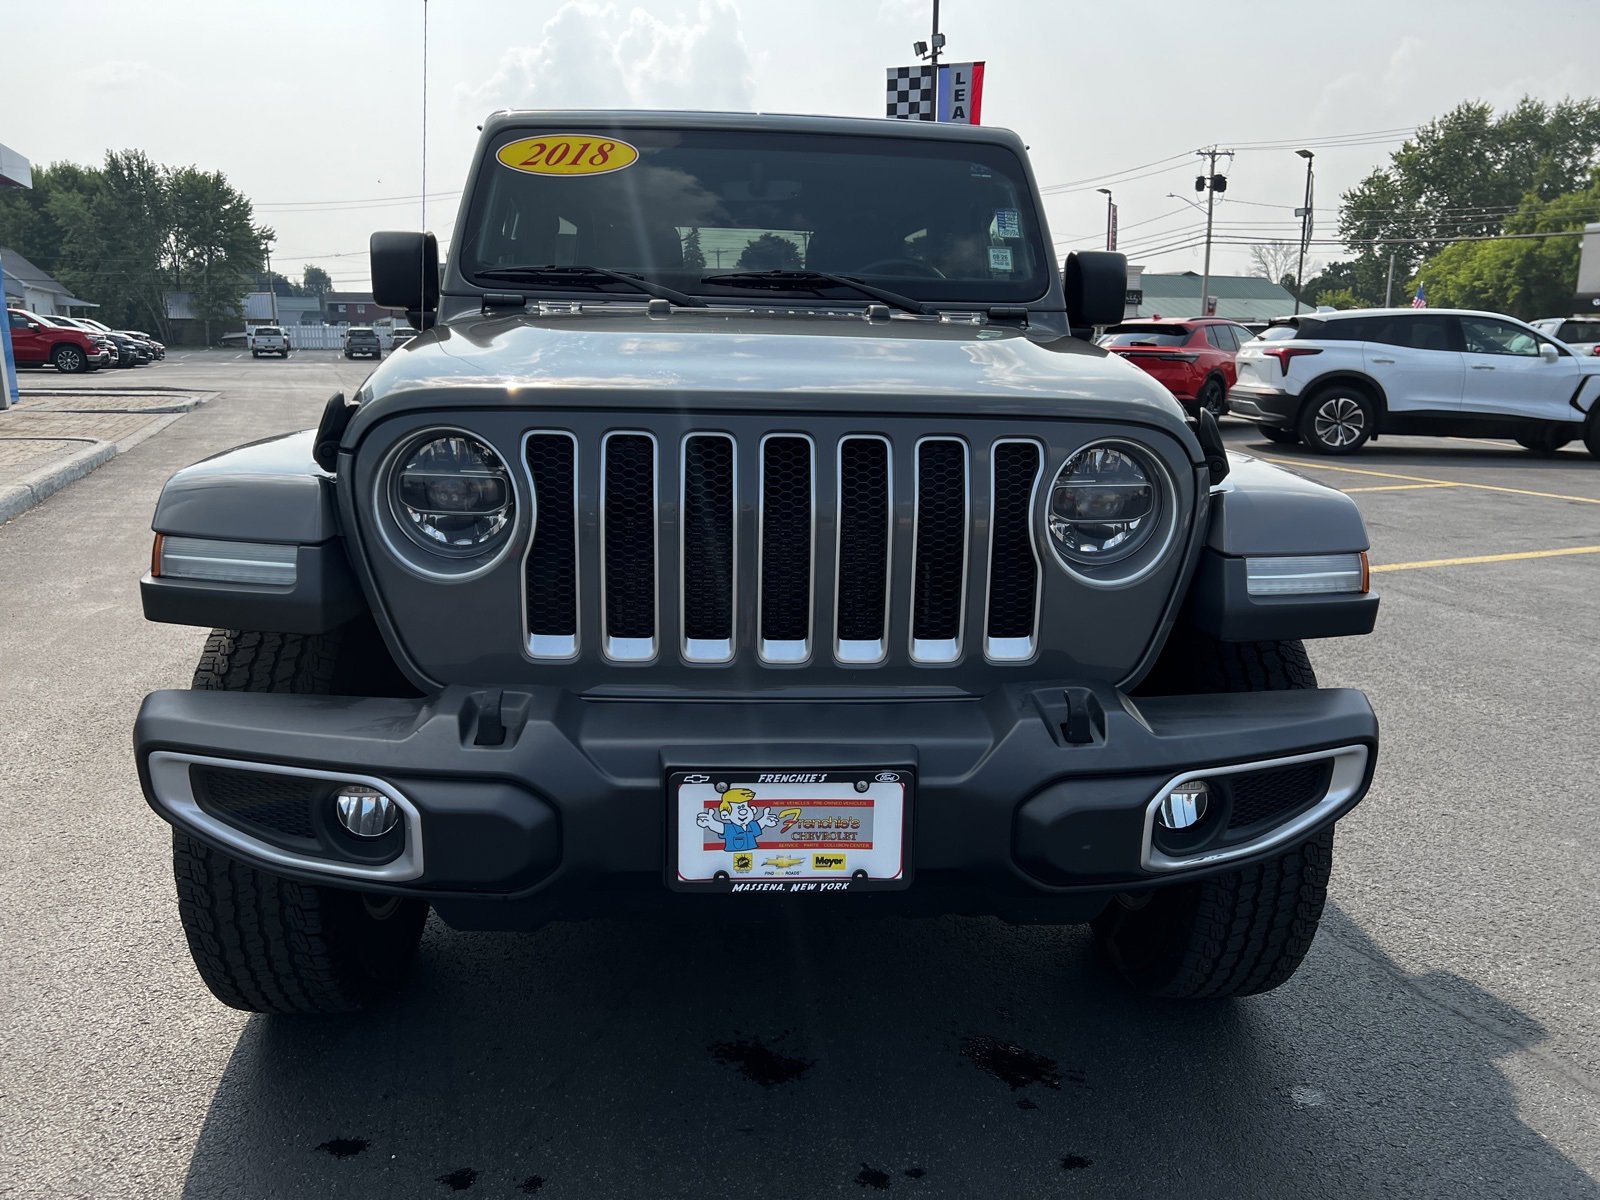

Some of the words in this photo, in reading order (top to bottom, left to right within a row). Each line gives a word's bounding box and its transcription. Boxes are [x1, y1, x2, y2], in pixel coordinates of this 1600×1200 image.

[519, 142, 616, 167] 2018
[758, 773, 828, 783] FRENCHIE'S
[878, 773, 897, 782] Ford
[779, 808, 861, 833] Frenchie's
[791, 831, 858, 841] CHEVROLET
[815, 857, 844, 867] Meyer
[790, 883, 817, 892] NEW
[820, 882, 850, 892] YORK
